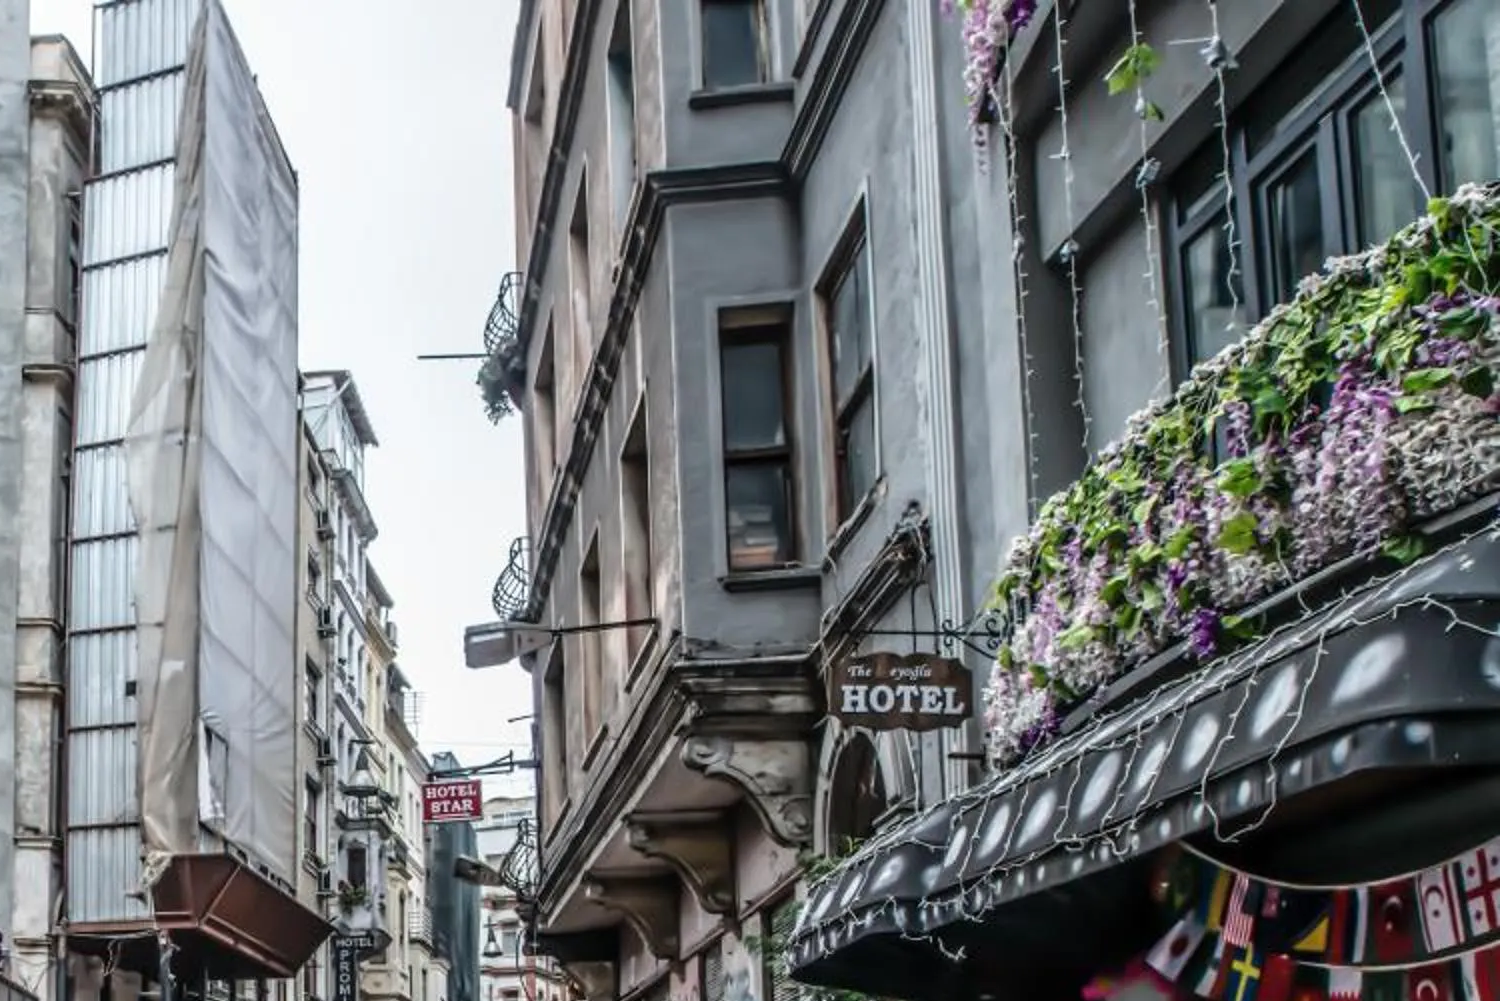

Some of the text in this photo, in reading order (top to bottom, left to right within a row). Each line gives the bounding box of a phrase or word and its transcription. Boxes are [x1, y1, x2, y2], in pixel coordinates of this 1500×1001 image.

[847, 664, 872, 677] The
[841, 685, 965, 714] HOTEL
[425, 783, 477, 799] HOTEL
[431, 799, 475, 813] STAR
[336, 937, 372, 947] HOTEL
